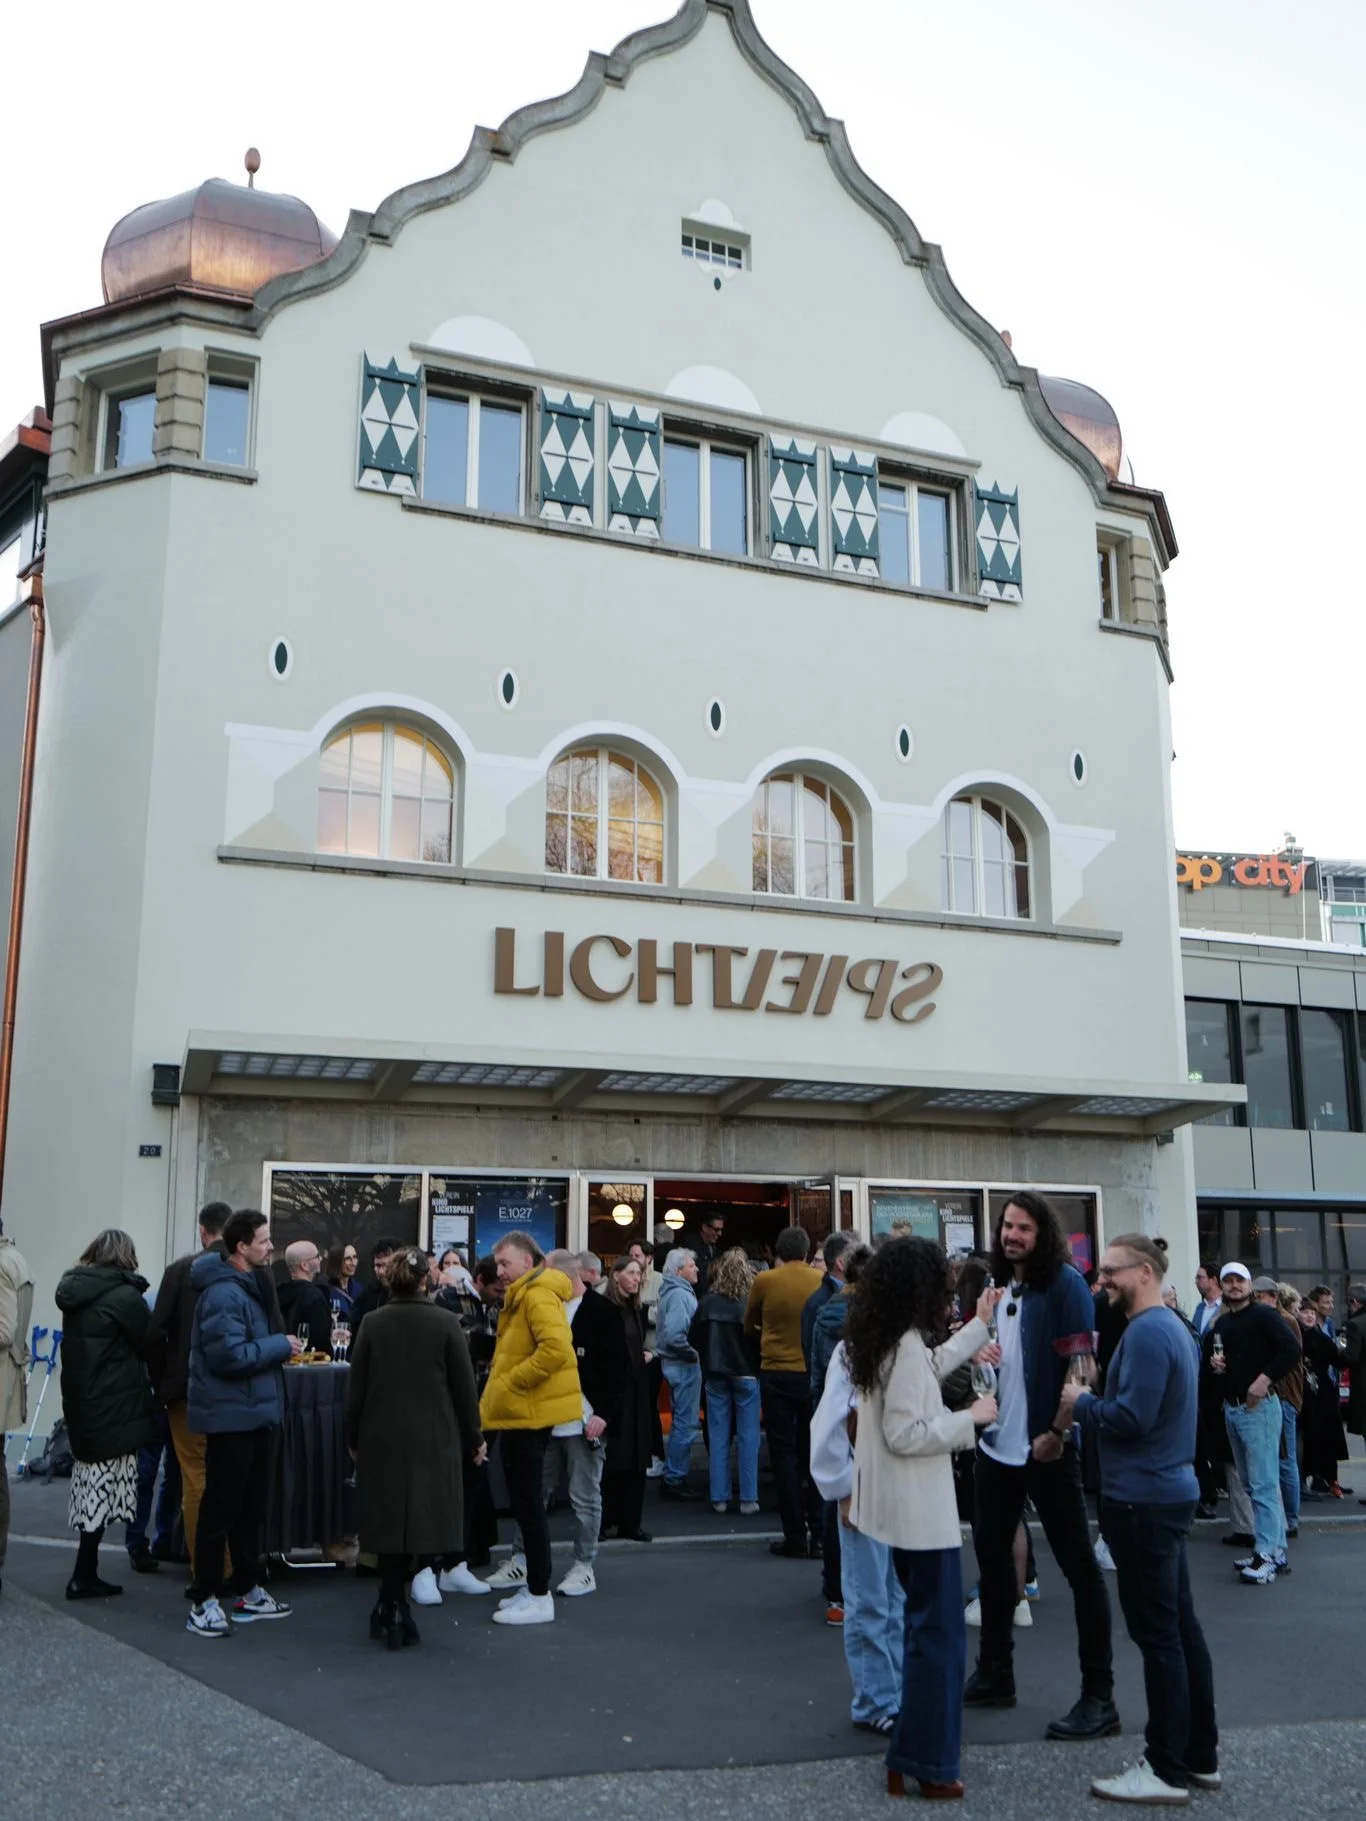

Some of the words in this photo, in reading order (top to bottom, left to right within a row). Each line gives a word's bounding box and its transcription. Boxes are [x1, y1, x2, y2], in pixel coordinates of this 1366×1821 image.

[1234, 855, 1309, 894] city
[431, 1197, 448, 1206] KINO
[434, 1206, 474, 1214] LICHTSPIELE
[498, 1206, 533, 1219] E.1027
